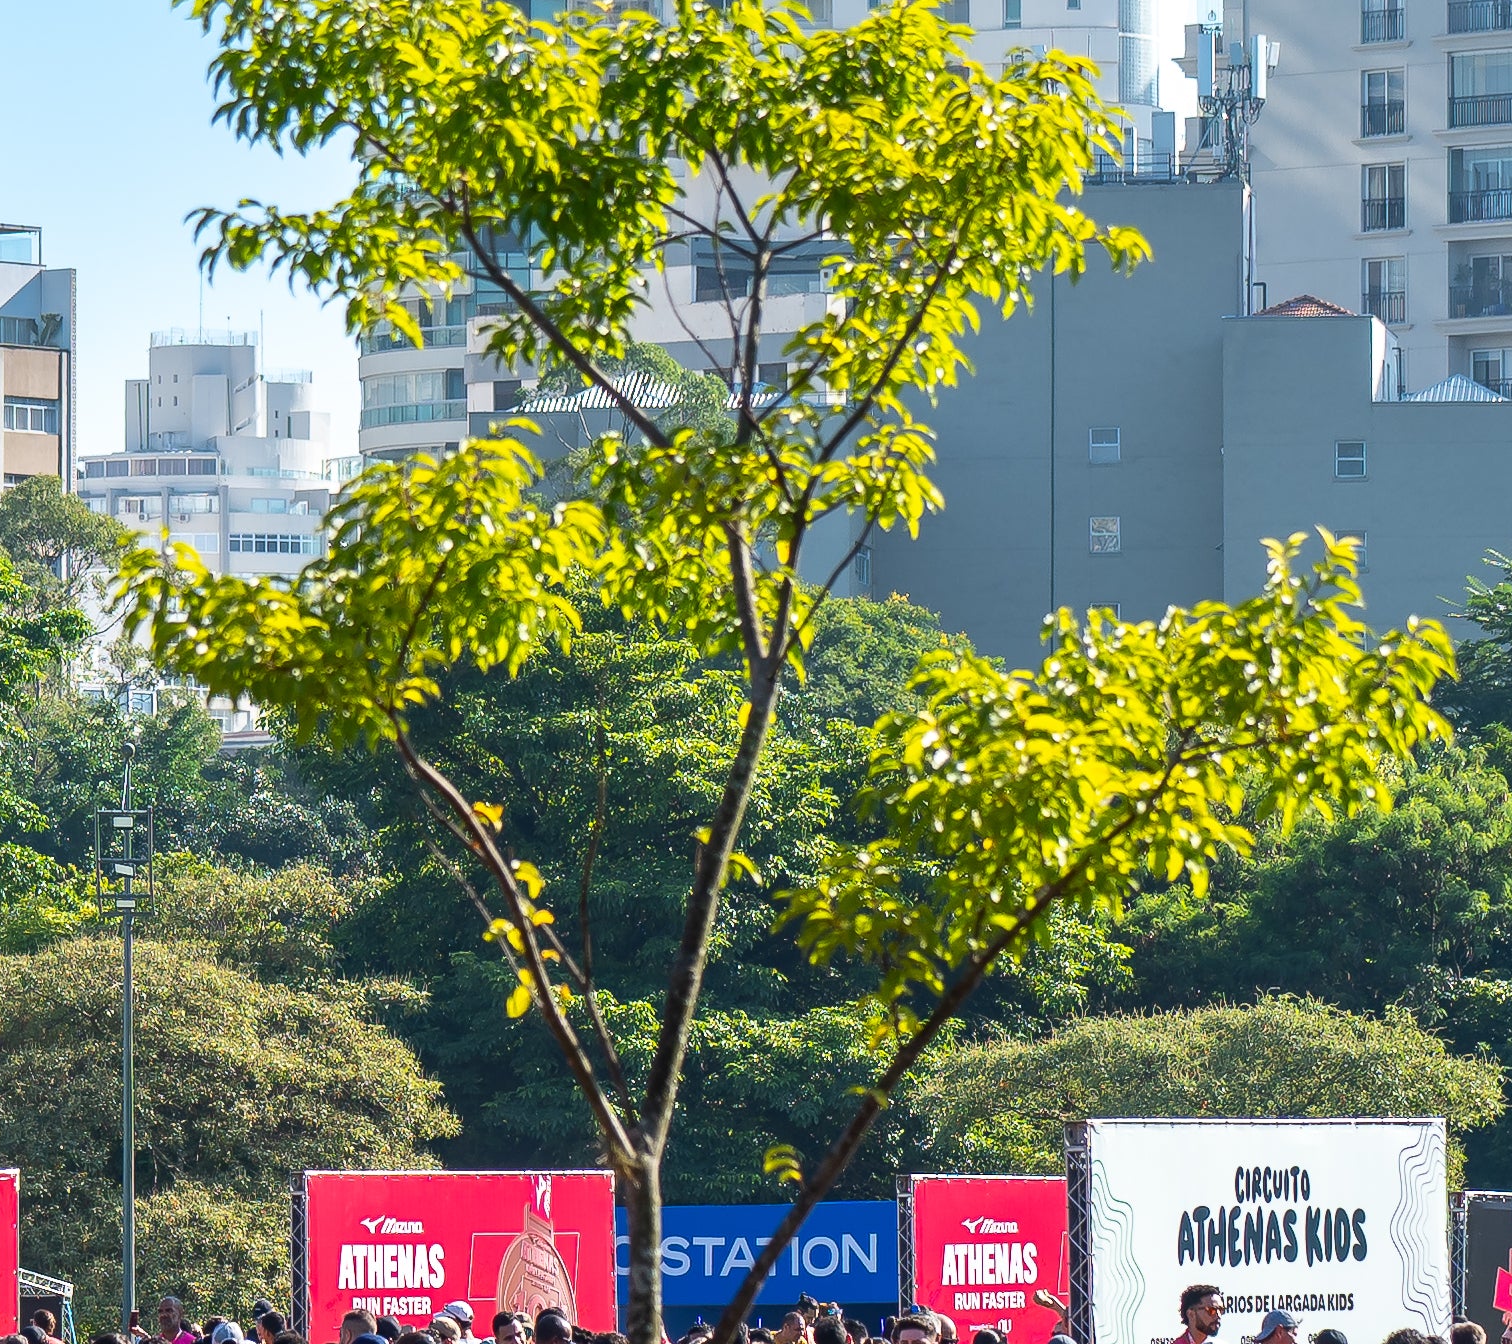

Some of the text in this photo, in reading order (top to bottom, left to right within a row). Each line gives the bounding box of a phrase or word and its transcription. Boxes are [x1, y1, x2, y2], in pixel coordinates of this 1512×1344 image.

[1234, 1166, 1311, 1203] CIRCUITO
[1177, 1205, 1368, 1268] ATHENAS KIDS
[338, 1243, 446, 1289] ATHENAS
[941, 1242, 1038, 1286] ATHENAS
[382, 1296, 432, 1316] FASTER
[954, 1291, 1026, 1311] RUN FASTER
[1255, 1295, 1270, 1313] DE
[1328, 1293, 1354, 1312] KIDS
